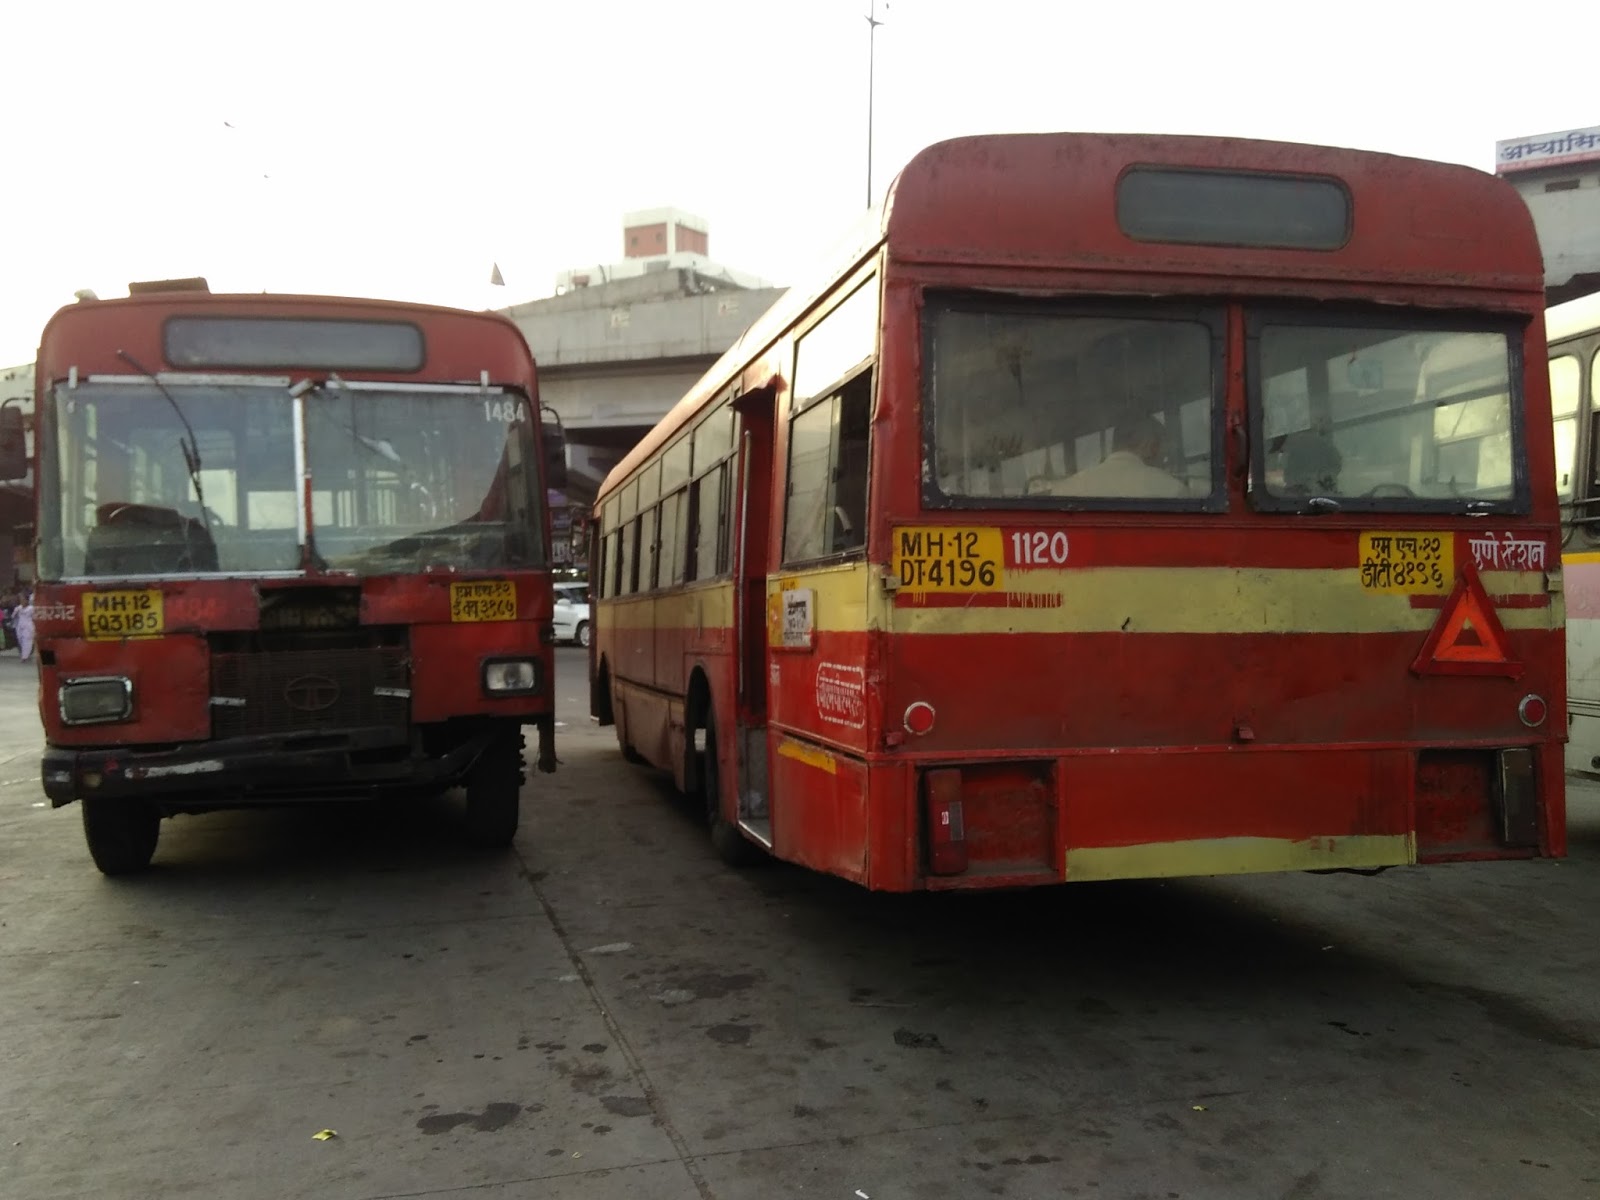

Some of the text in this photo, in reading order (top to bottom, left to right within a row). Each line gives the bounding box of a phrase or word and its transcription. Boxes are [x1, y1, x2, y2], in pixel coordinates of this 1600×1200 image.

[1501, 132, 1600, 160] अभ्यासि
[484, 401, 526, 423] 1484
[1012, 531, 1069, 564] 1120
[1370, 537, 1393, 559] एम
[1468, 531, 1547, 571] पुणे स्टेशन
[88, 612, 158, 633] EQ3185
